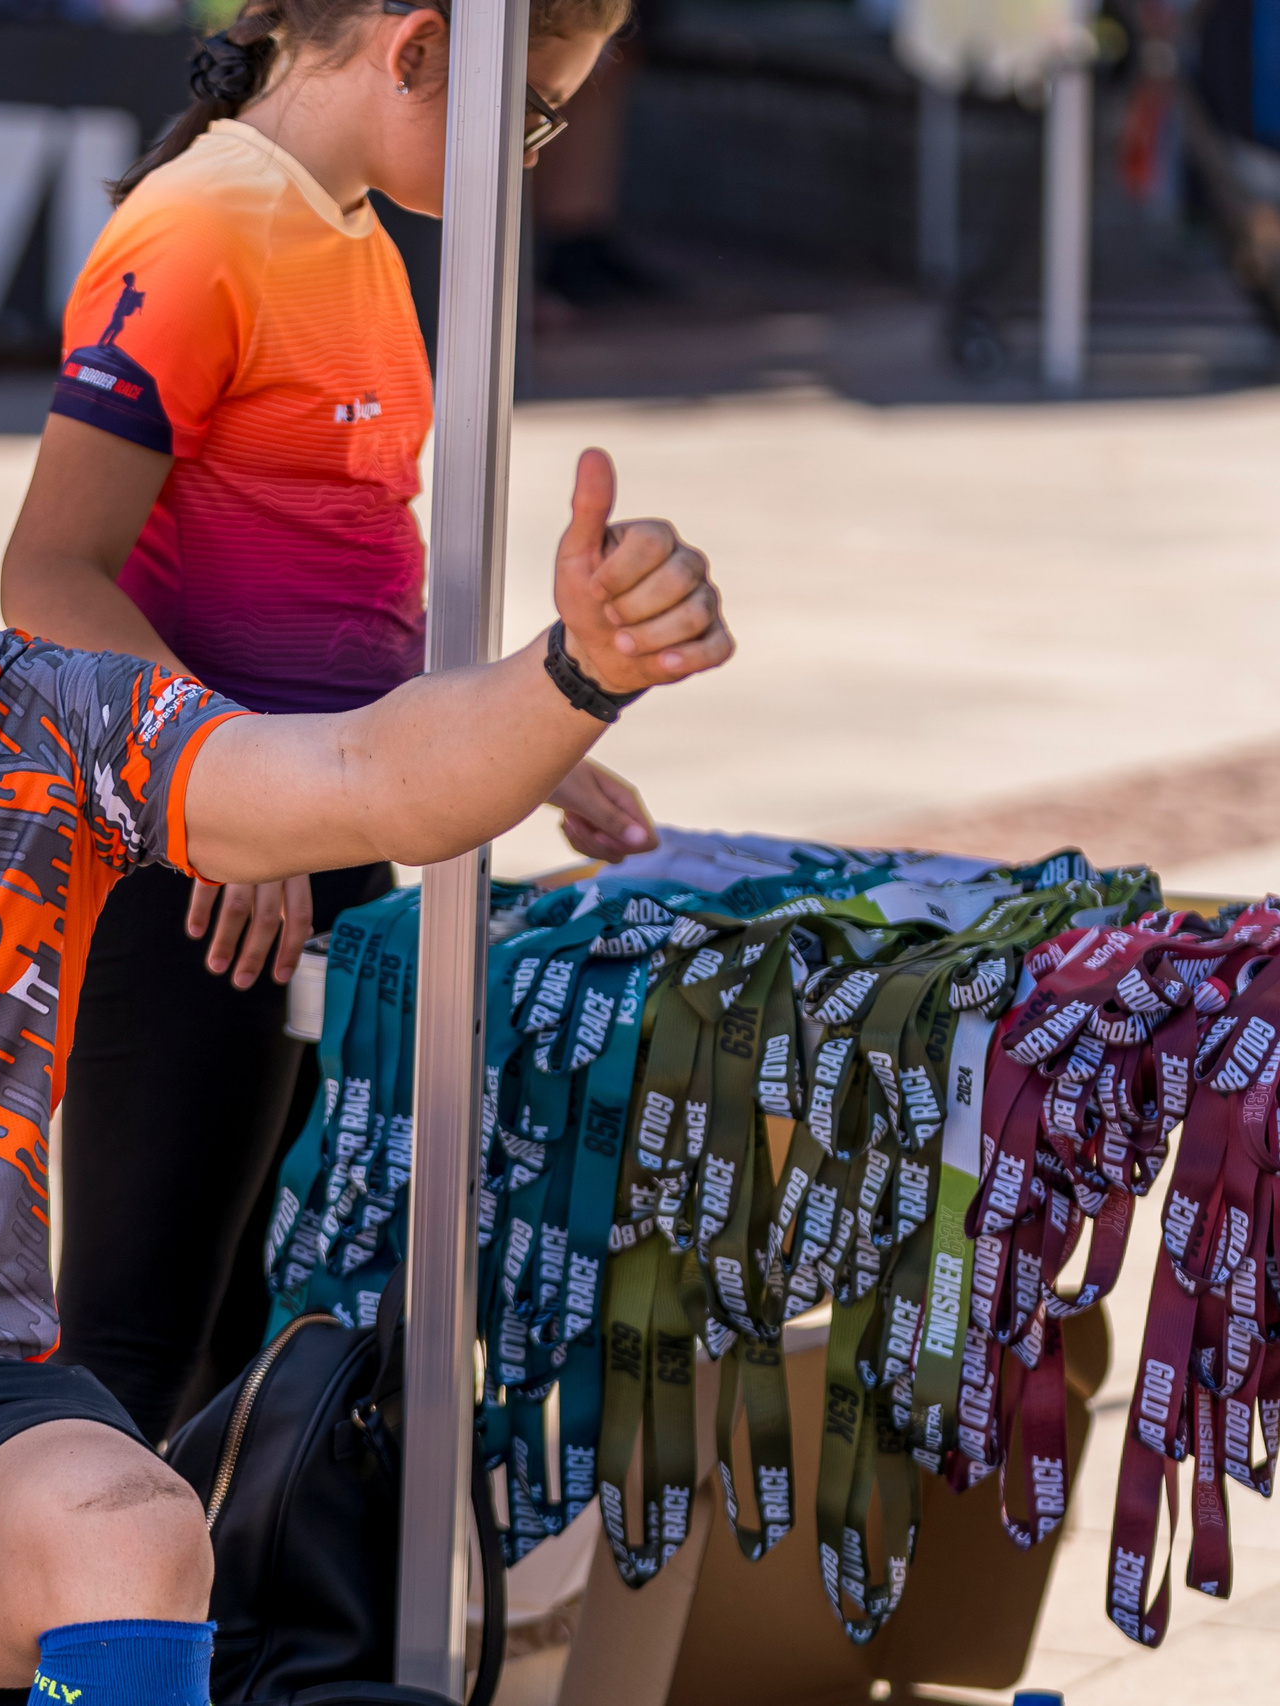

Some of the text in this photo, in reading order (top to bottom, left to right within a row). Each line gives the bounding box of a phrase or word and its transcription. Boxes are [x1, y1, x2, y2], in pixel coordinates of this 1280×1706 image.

[330, 922, 366, 976] 85K
[536, 959, 574, 1010] RACE
[834, 968, 880, 1010] RACE
[576, 986, 615, 1052] RACE
[720, 1006, 759, 1060] 63K
[1043, 999, 1094, 1041] RACE
[1233, 1015, 1276, 1073] GOLD
[760, 1034, 790, 1078] GOLD
[957, 1064, 974, 1106] 2024
[1161, 1051, 1190, 1115] RACE
[338, 1076, 371, 1131] RACE
[638, 1090, 675, 1151] GOLD
[899, 1065, 942, 1122] RACE
[386, 1112, 413, 1166] RACE
[584, 1096, 624, 1157] 85K
[686, 1099, 708, 1158] RACE
[702, 1153, 735, 1219] RACE
[778, 1166, 809, 1228] GOLD
[859, 1147, 890, 1208] GOLD
[898, 1157, 930, 1222] RACE
[987, 1150, 1025, 1217] RACE
[270, 1186, 300, 1241] GOLD
[805, 1179, 838, 1244] RACE
[1164, 1189, 1200, 1259] RACE
[1226, 1206, 1250, 1269] GOLD
[504, 1216, 534, 1280] GOLD
[540, 1221, 569, 1282] RACE
[972, 1234, 1003, 1297] GOLD
[565, 1251, 600, 1316] RACE
[713, 1255, 749, 1314] GOLD
[924, 1204, 967, 1360] FINISHER 63K
[1016, 1248, 1042, 1315] RACE
[1231, 1256, 1258, 1318] GOLD
[611, 1319, 643, 1382] 63K
[887, 1294, 922, 1359] RACE
[657, 1329, 692, 1386] 63K
[827, 1382, 861, 1445] 63K
[1140, 1358, 1175, 1422] GOLD
[1224, 1397, 1251, 1464] GOLD
[565, 1443, 595, 1501] RACE
[759, 1464, 791, 1522] RACE
[1032, 1454, 1066, 1516] RACE
[662, 1483, 690, 1540] RACE
[1195, 1482, 1224, 1527] 43K
[1113, 1545, 1146, 1611] RACE
